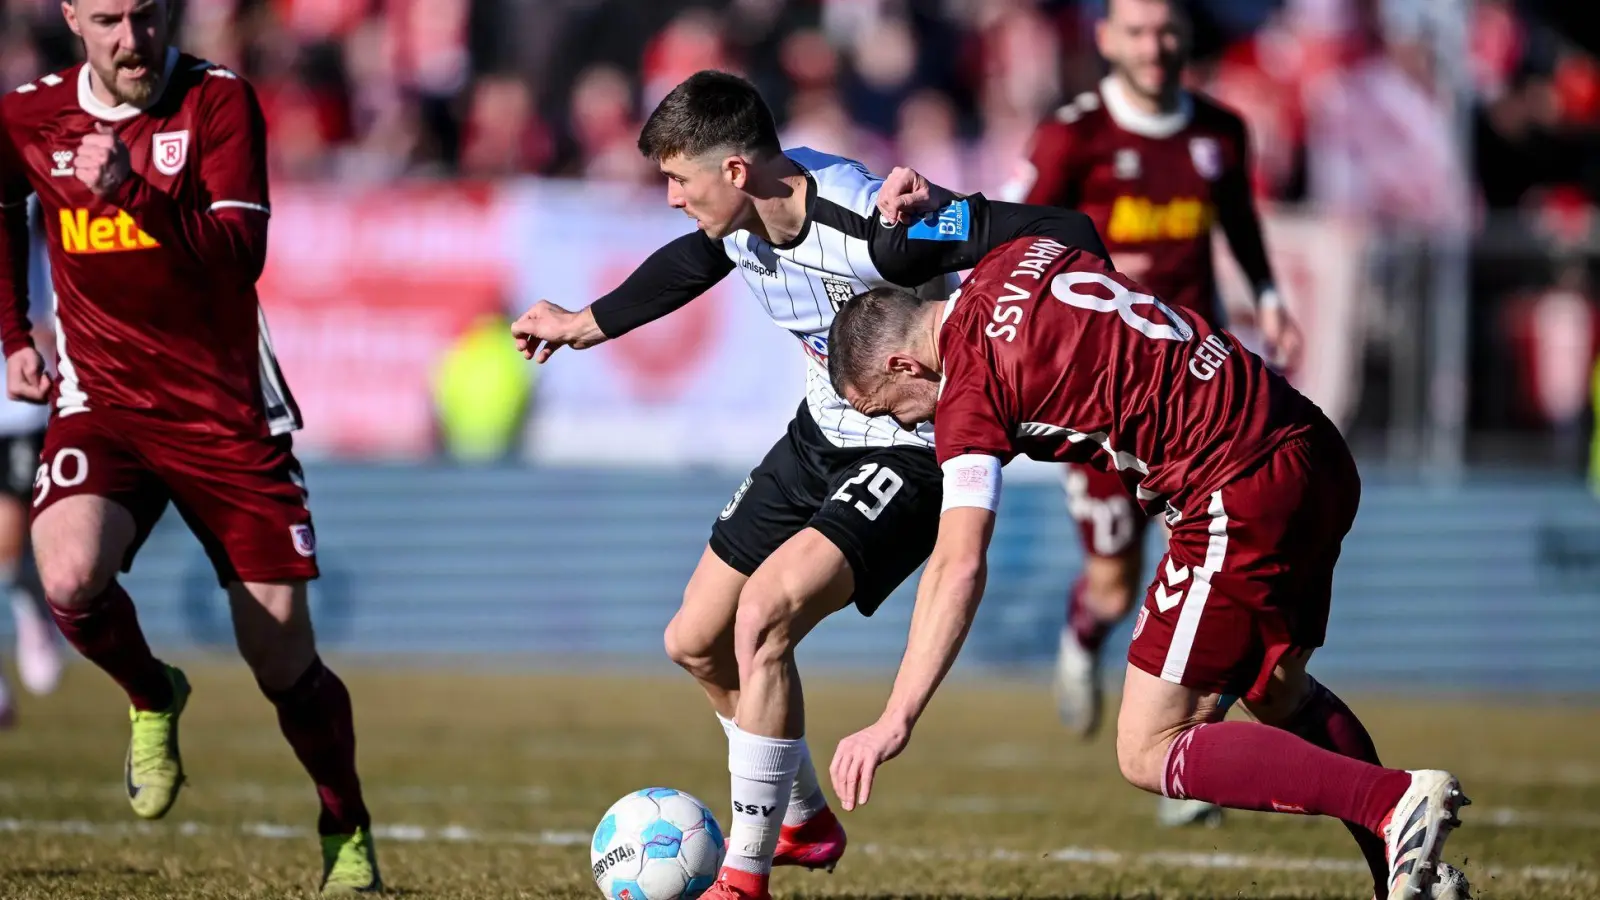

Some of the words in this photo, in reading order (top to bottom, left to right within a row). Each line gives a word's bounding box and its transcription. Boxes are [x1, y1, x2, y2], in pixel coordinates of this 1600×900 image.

[742, 259, 778, 279] uhlsport
[825, 283, 851, 294] SSV
[985, 282, 1031, 343] SSV
[1010, 238, 1068, 280] JAHN
[1050, 271, 1194, 342] 8
[1188, 334, 1232, 381] GEIP
[830, 462, 903, 522] 29
[734, 800, 776, 817] SSV
